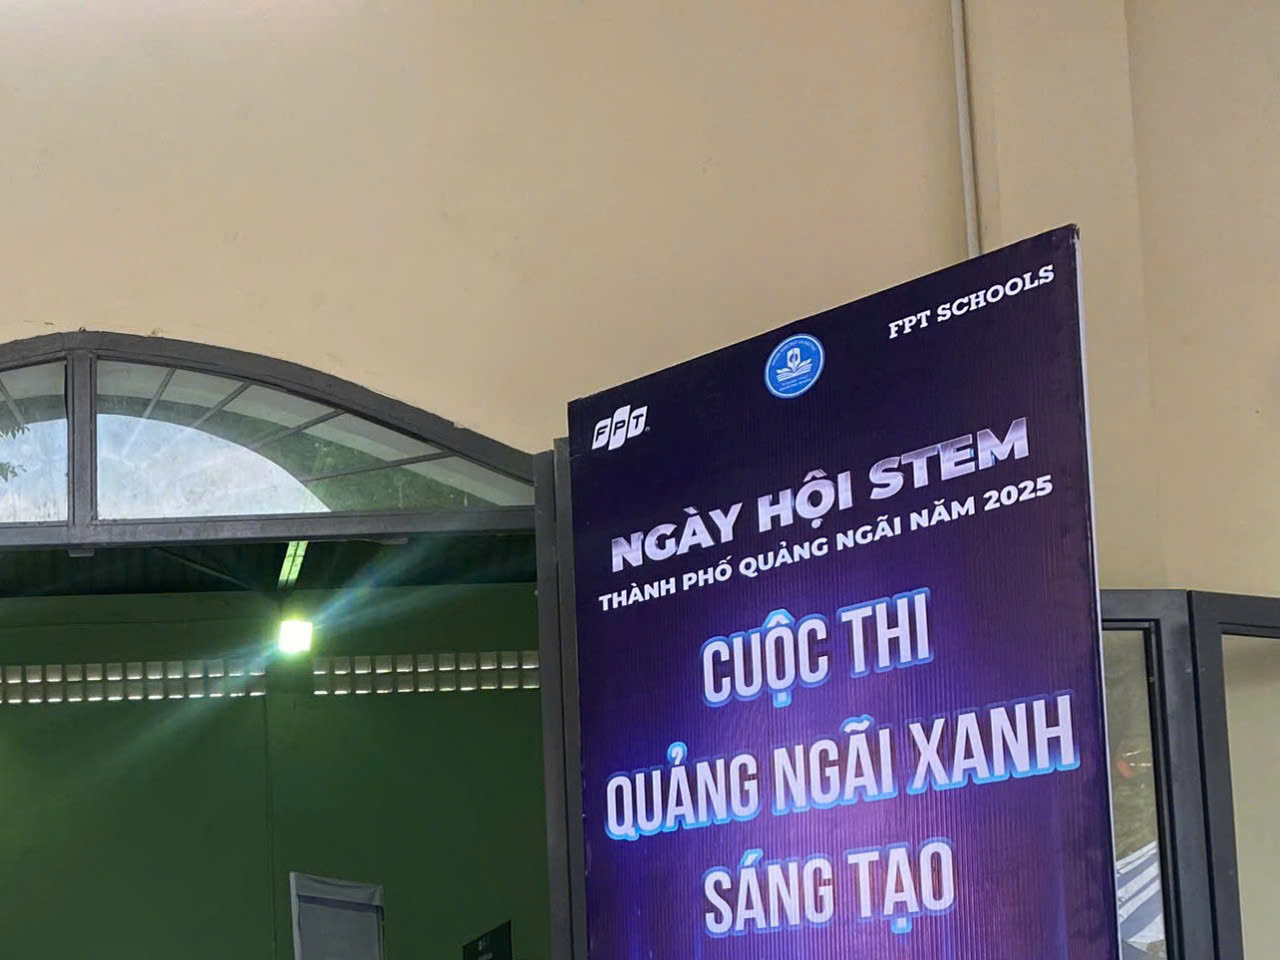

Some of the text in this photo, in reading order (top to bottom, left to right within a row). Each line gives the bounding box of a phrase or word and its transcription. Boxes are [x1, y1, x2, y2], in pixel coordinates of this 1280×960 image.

[888, 264, 1055, 340] FPT SCHOOLS
[592, 404, 648, 451] FPT
[599, 475, 1053, 612] THÀNH PHỐ QUẢNG NGÃI NĂM 2025
[611, 417, 1030, 573] NGÀY HỘI STEM
[703, 590, 932, 706] CUỘC THI
[605, 692, 1080, 840] QUẢNG NGÃI XANH
[704, 838, 955, 936] SÁNG TẠO
